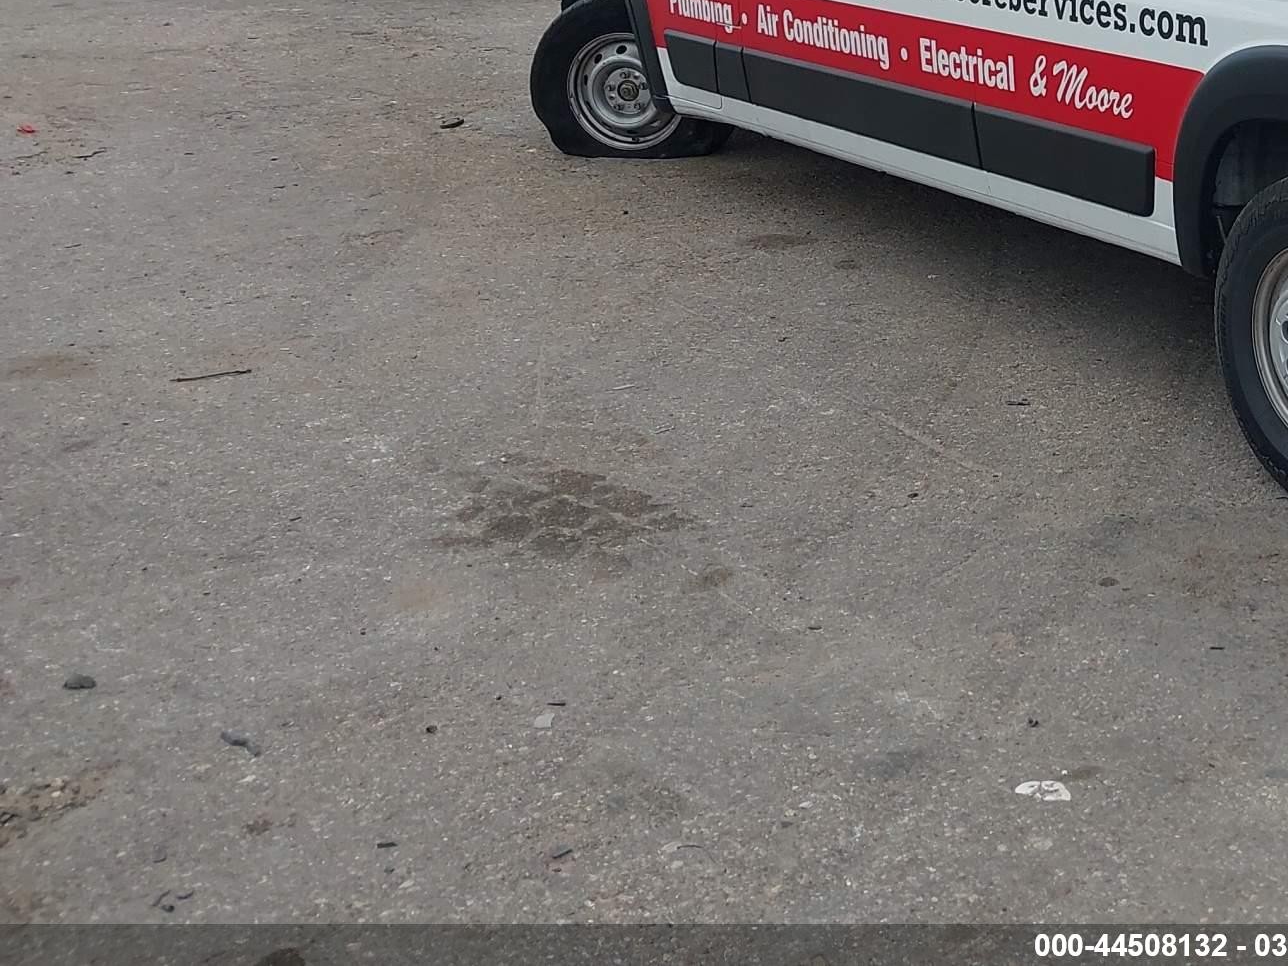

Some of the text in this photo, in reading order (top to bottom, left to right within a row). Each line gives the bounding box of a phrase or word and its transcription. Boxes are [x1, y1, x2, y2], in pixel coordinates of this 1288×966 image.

[757, 4, 779, 38] Air
[783, 9, 890, 70] Conditioning
[919, 37, 1015, 92] Electrical
[1029, 55, 1048, 98] &
[1052, 60, 1134, 120] Moore
